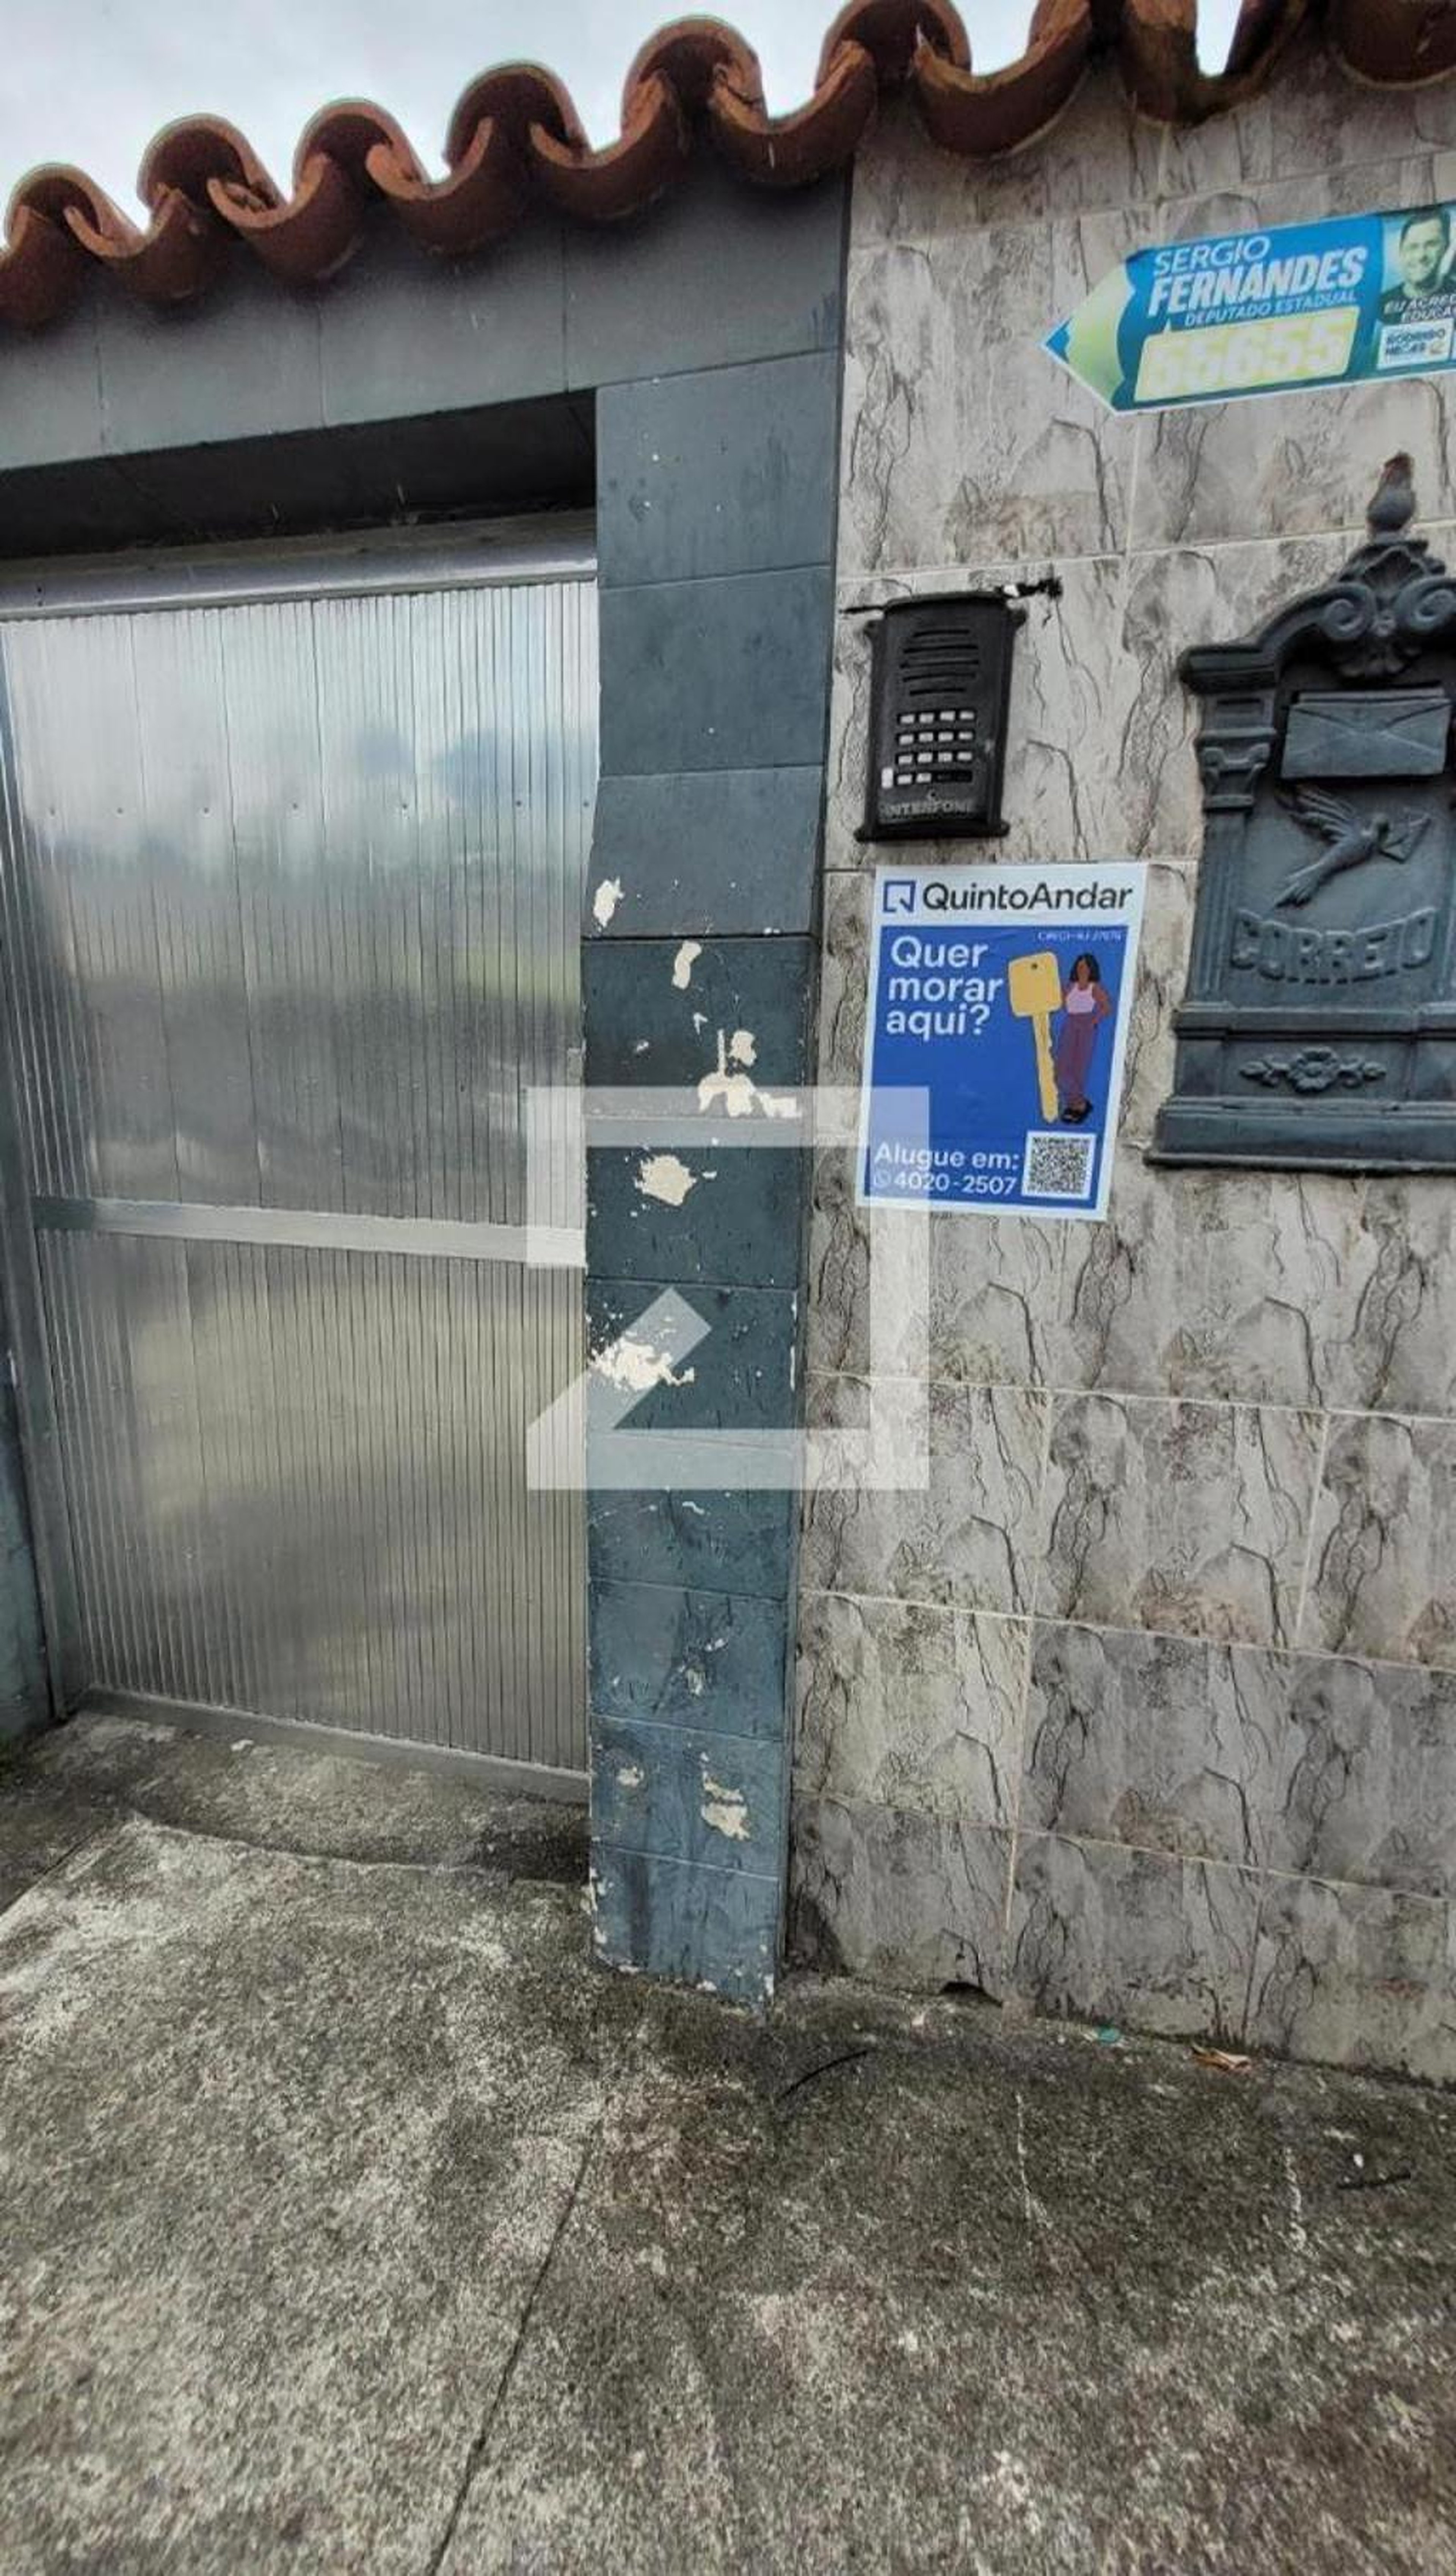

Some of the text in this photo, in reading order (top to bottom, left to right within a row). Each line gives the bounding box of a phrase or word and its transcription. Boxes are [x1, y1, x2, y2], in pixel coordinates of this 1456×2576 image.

[1153, 236, 1271, 276] SERGIO
[1148, 246, 1368, 317] FERNANDES
[1184, 290, 1357, 327] DEPUTADO ESTADUAL
[1147, 312, 1351, 391] 55655
[923, 882, 1133, 911] QuintoAndar
[891, 935, 988, 969] Quer
[1230, 908, 1436, 984] CORREIO
[888, 977, 1003, 1002] morar
[886, 1003, 990, 1042] aqui?
[874, 1142, 1020, 1171] Alugue em:
[893, 1169, 1017, 1196] 4020-2507
